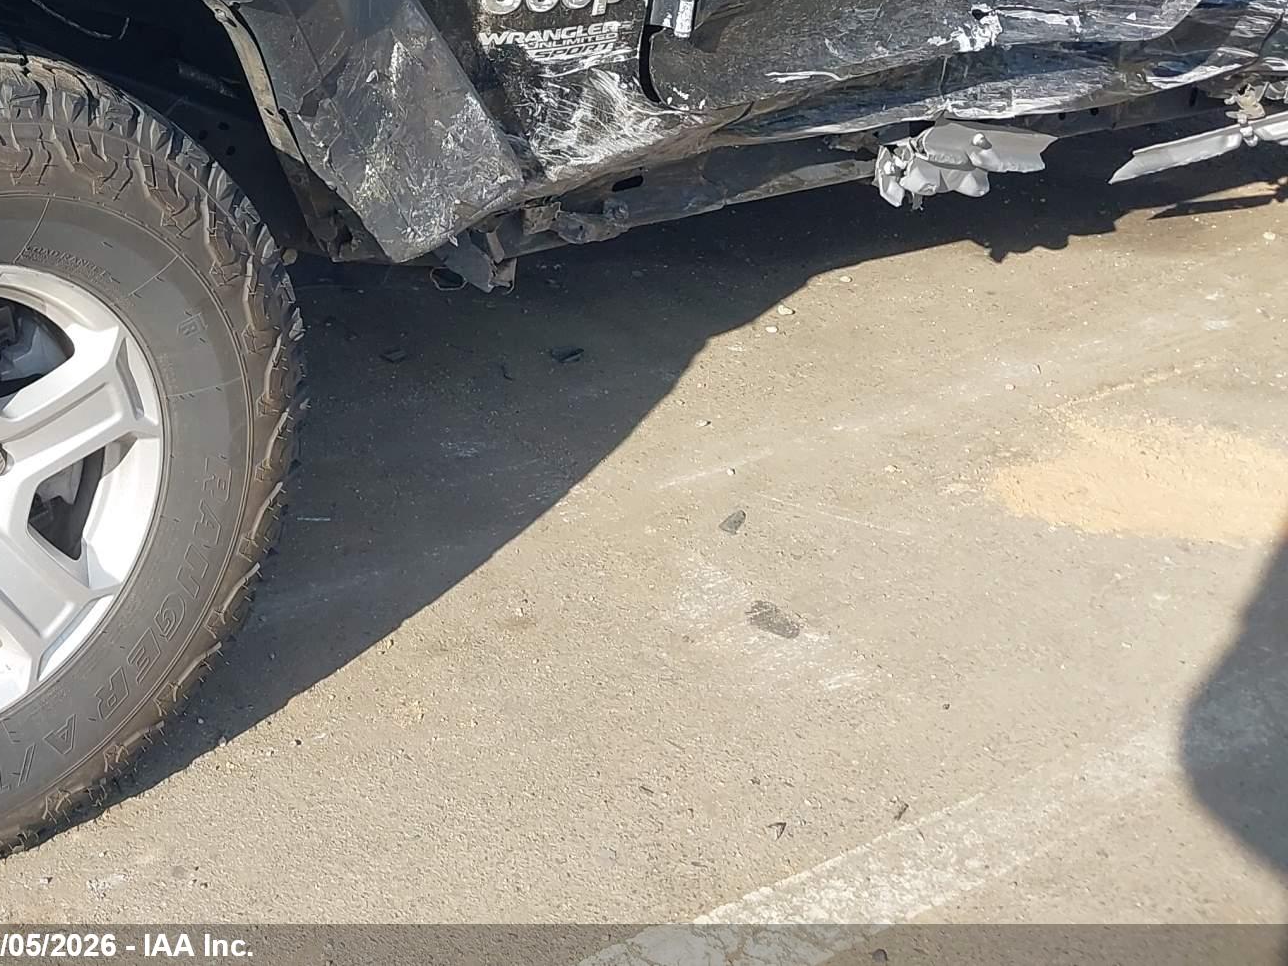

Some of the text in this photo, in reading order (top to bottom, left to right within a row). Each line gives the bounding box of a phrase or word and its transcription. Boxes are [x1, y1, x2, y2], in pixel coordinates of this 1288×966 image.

[479, 20, 621, 46] WRANGLER
[518, 32, 618, 50] UNLIMITED
[534, 43, 614, 59] SPORT
